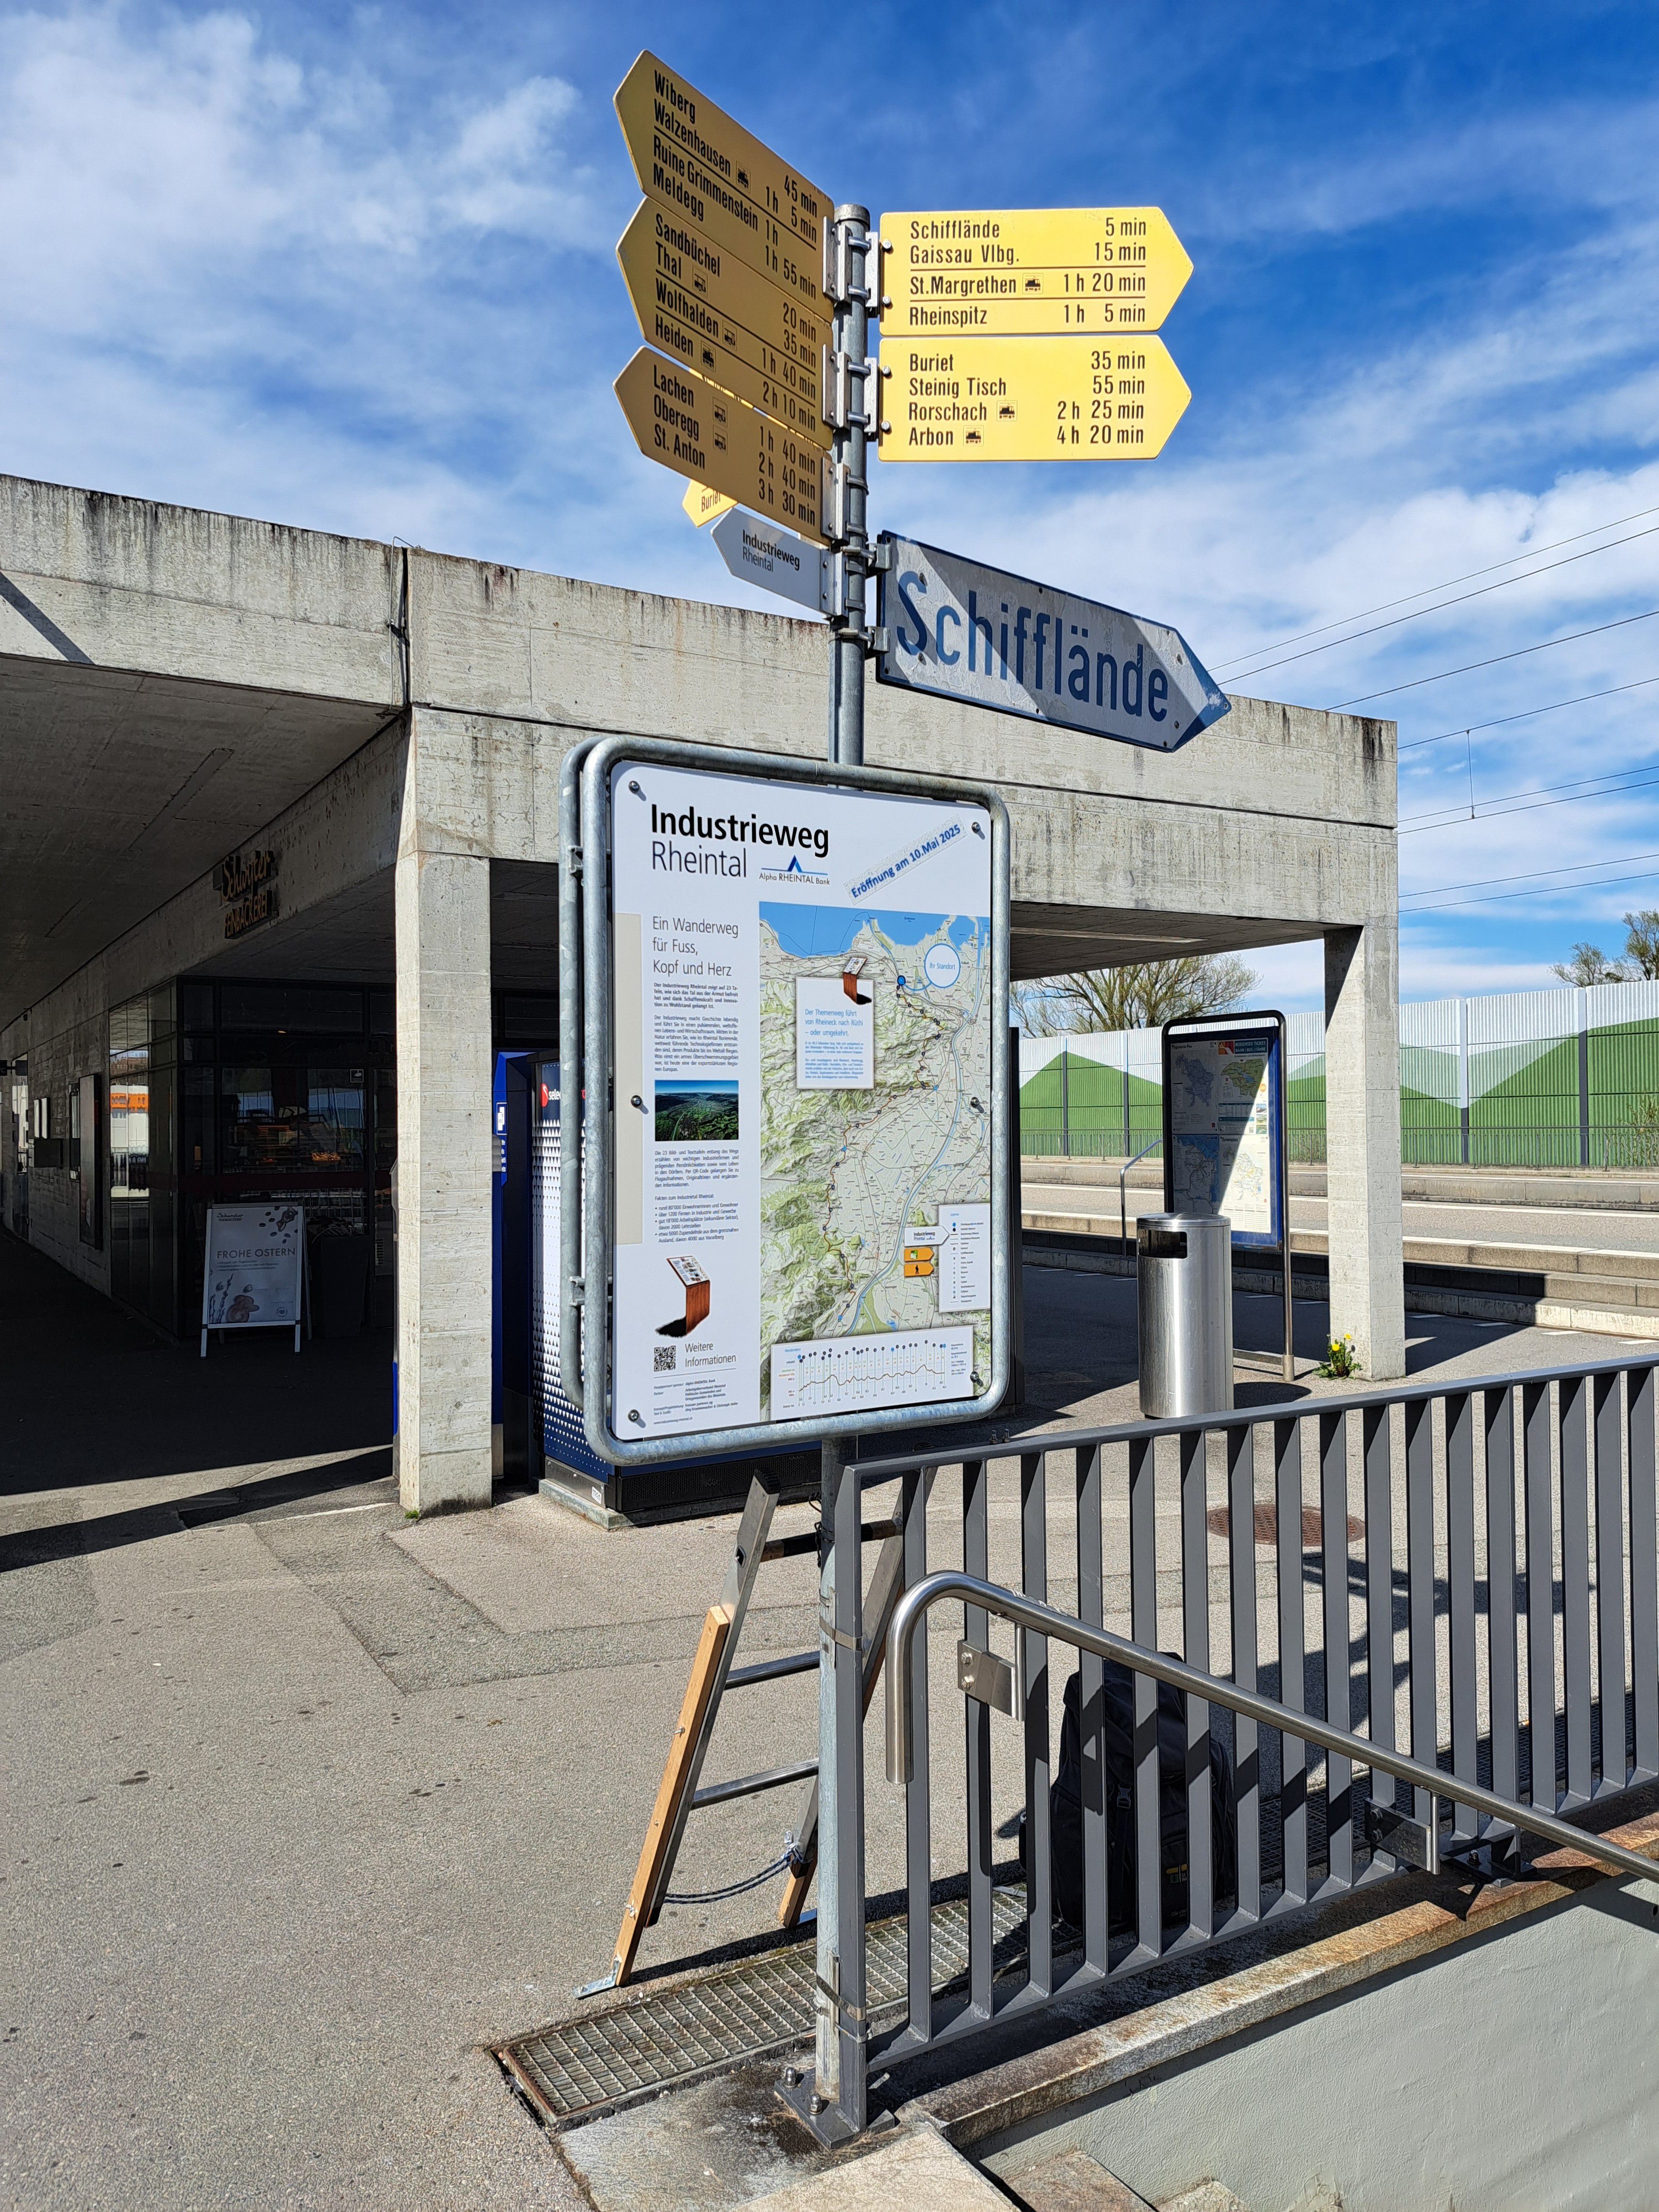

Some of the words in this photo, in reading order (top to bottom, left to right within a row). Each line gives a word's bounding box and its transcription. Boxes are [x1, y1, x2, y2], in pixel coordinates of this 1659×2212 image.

[654, 69, 695, 124] Wiberg
[785, 175, 797, 202] 45
[801, 192, 817, 218] min
[654, 99, 730, 177] Walzenhausen
[766, 187, 770, 207] 1
[772, 191, 778, 213] h
[791, 205, 797, 228] 5
[801, 218, 817, 243] min
[654, 134, 685, 177] Ruine
[687, 161, 758, 232] Grimmenstein
[766, 220, 770, 240] 1
[772, 223, 778, 246] h
[653, 163, 704, 222] Meldegg
[765, 245, 769, 266] 1
[772, 250, 778, 272] h
[784, 258, 796, 285] 55
[800, 275, 816, 300] min
[910, 220, 1000, 239] Schifflände
[1106, 217, 1115, 236] 5
[1120, 218, 1146, 236] min
[910, 245, 972, 264] Gaissau
[981, 244, 1019, 265] Vlbg.
[1095, 243, 1113, 261] 15
[1118, 242, 1146, 261] min
[656, 213, 720, 277] Sandbüchel
[783, 302, 796, 329] 20
[800, 318, 816, 343] min
[910, 276, 1017, 296] St.Margrethen
[1063, 274, 1069, 293] 1
[1076, 274, 1084, 292] h
[1093, 273, 1113, 292] 20
[1118, 273, 1145, 291] min
[655, 240, 681, 280] Thal
[784, 329, 796, 354] 35
[800, 343, 816, 368] min
[909, 307, 987, 329] Rheinspitz
[1063, 304, 1069, 323] 1
[1076, 304, 1084, 322] h
[1104, 304, 1113, 322] 5
[1119, 303, 1145, 322] min
[655, 277, 718, 338] Wolfhalden
[763, 347, 765, 368] 1
[771, 352, 775, 376] h
[783, 361, 796, 387] 40
[799, 375, 815, 400] min
[655, 313, 693, 357] Heiden
[763, 381, 769, 404] 2
[773, 386, 777, 409] h
[784, 394, 795, 420] 10
[799, 407, 815, 432] min
[909, 354, 953, 372] Buriet
[1091, 351, 1111, 370] 35
[1117, 351, 1145, 369] min
[909, 378, 959, 398] Steinig
[967, 377, 1006, 396] Tisch
[1093, 376, 1113, 395] 55
[1118, 376, 1145, 394] min
[653, 365, 694, 408] Lachen
[760, 426, 763, 447] 1
[768, 430, 773, 453] h
[783, 439, 796, 464] 40
[799, 452, 815, 476] min
[909, 402, 987, 421] Rorschach
[1057, 401, 1066, 420] 2
[1071, 401, 1080, 420] h
[1092, 400, 1112, 420] 25
[1117, 400, 1144, 419] min
[653, 394, 699, 442] Oberegg
[759, 452, 765, 474] 2
[769, 456, 773, 479] h
[783, 465, 795, 490] 40
[799, 478, 815, 501] min
[909, 427, 953, 446] Arbon
[1057, 426, 1066, 444] 4
[1071, 425, 1079, 444] h
[1090, 425, 1111, 444] 20
[1117, 425, 1144, 443] min
[654, 423, 669, 452] St.
[674, 433, 705, 470] Anton
[759, 478, 765, 500] 3
[768, 483, 773, 506] h
[782, 490, 795, 516] 30
[798, 502, 815, 527] min
[742, 529, 799, 571] Industrieweg
[743, 546, 773, 573] Rheintal
[896, 570, 1168, 723] Schifflände
[652, 804, 829, 857] Industrieweg
[652, 841, 747, 878] Rheintal
[852, 867, 895, 898] Eröffnung
[896, 858, 909, 871] am
[940, 824, 960, 843] 2025
[759, 873, 776, 882] Alpha
[779, 874, 814, 883] RHEINTAL
[653, 916, 668, 930] Ein
[673, 918, 738, 938] Wanderweg
[653, 937, 668, 951] für
[673, 939, 697, 956] Fuss,
[654, 959, 679, 977] Kopf
[683, 961, 703, 974] und
[708, 962, 731, 976] Herz
[815, 1009, 844, 1017] Themenweg
[548, 1089, 561, 1100] sele
[217, 1250, 251, 1259] FROHE
[255, 1248, 295, 1257] OSTERN
[685, 1342, 713, 1352] Weitere
[686, 1355, 736, 1367] Informationen
